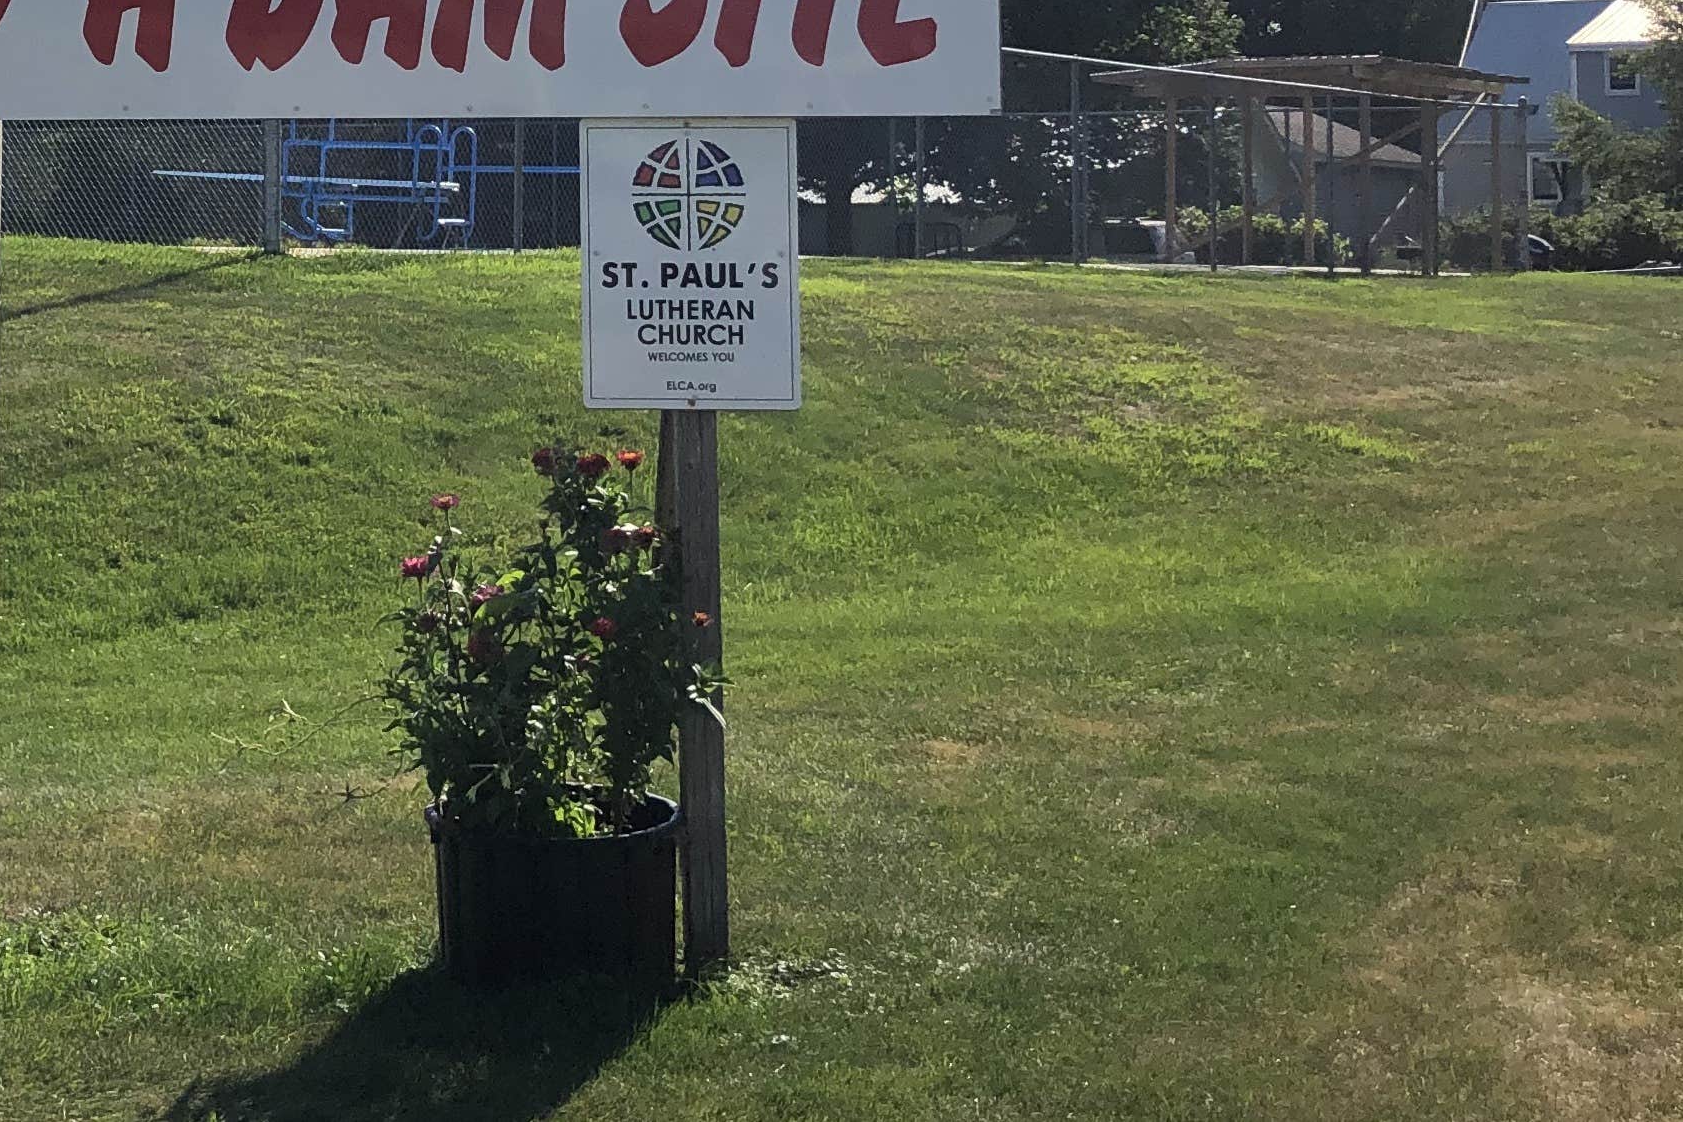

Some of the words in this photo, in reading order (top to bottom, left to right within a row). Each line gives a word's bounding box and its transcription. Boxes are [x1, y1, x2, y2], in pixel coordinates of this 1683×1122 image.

[601, 261, 650, 289] ST.
[660, 262, 779, 289] PAUL'S
[627, 299, 755, 321] LUTHERAN
[637, 324, 744, 346] CHURCH
[648, 352, 709, 363] WELCOMES
[711, 352, 735, 363] YOU
[666, 381, 717, 393] ELCA.org
